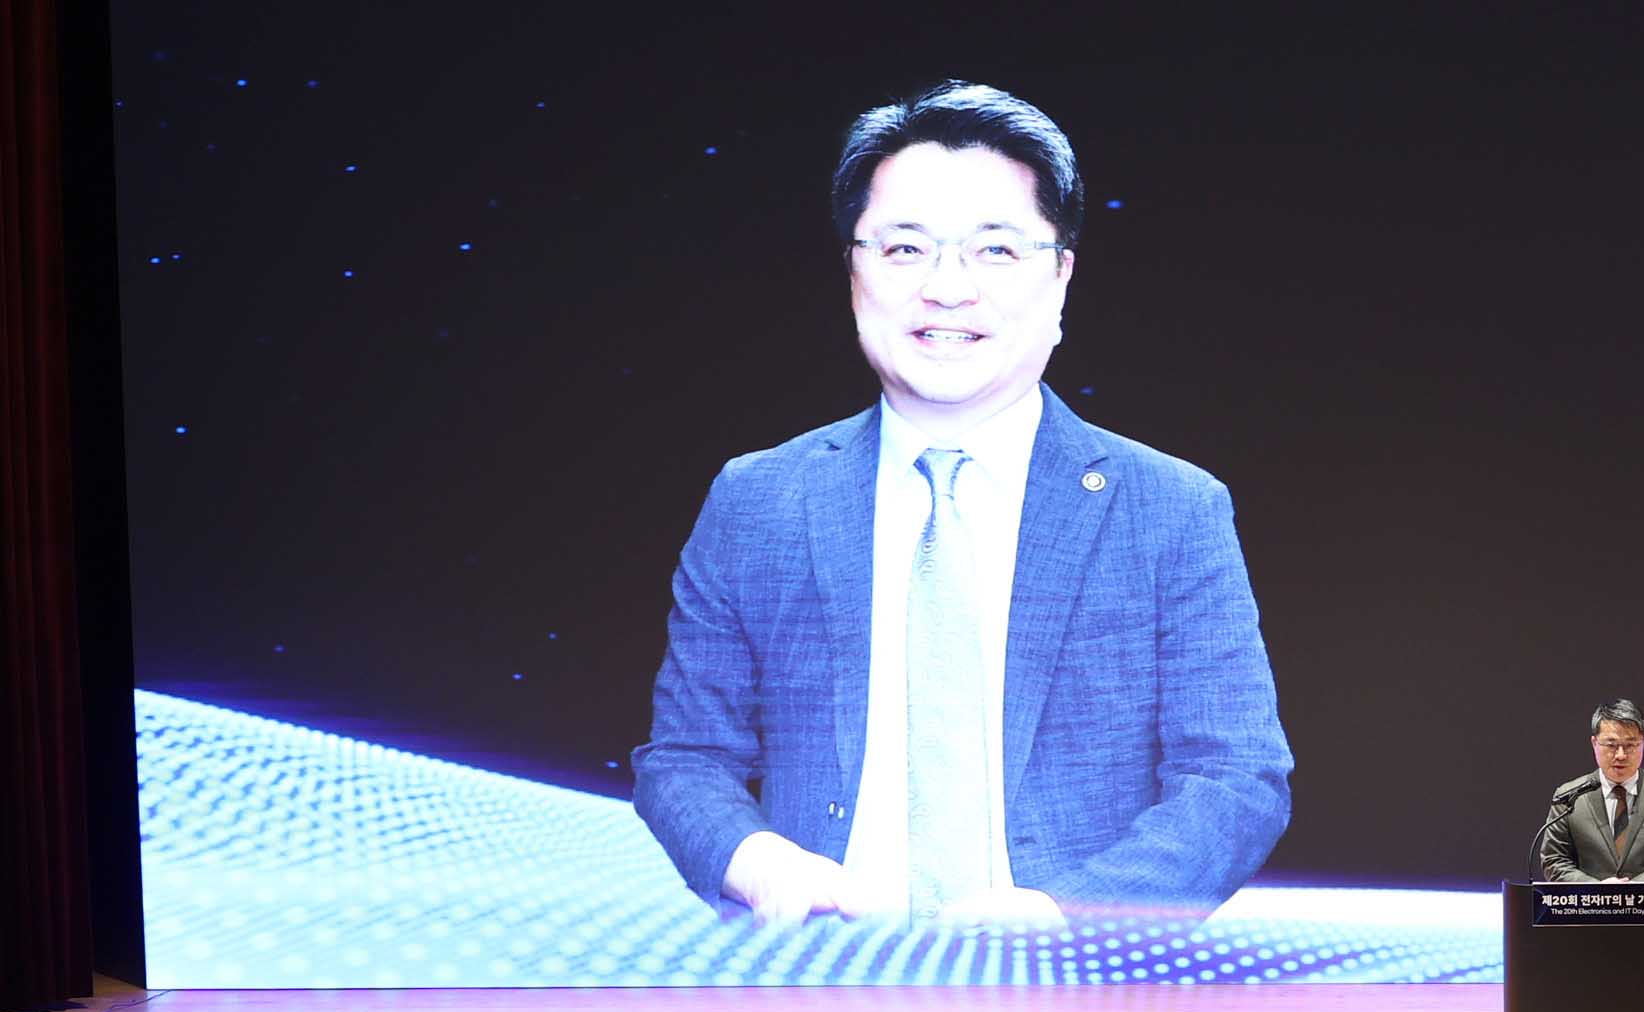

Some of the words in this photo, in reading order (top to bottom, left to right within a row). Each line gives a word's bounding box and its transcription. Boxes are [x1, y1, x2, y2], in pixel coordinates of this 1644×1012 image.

[1542, 894, 1578, 906] 제20회
[1580, 894, 1622, 906] 전자IT의
[1624, 894, 1635, 906] 날
[1632, 908, 1644, 916] Day
